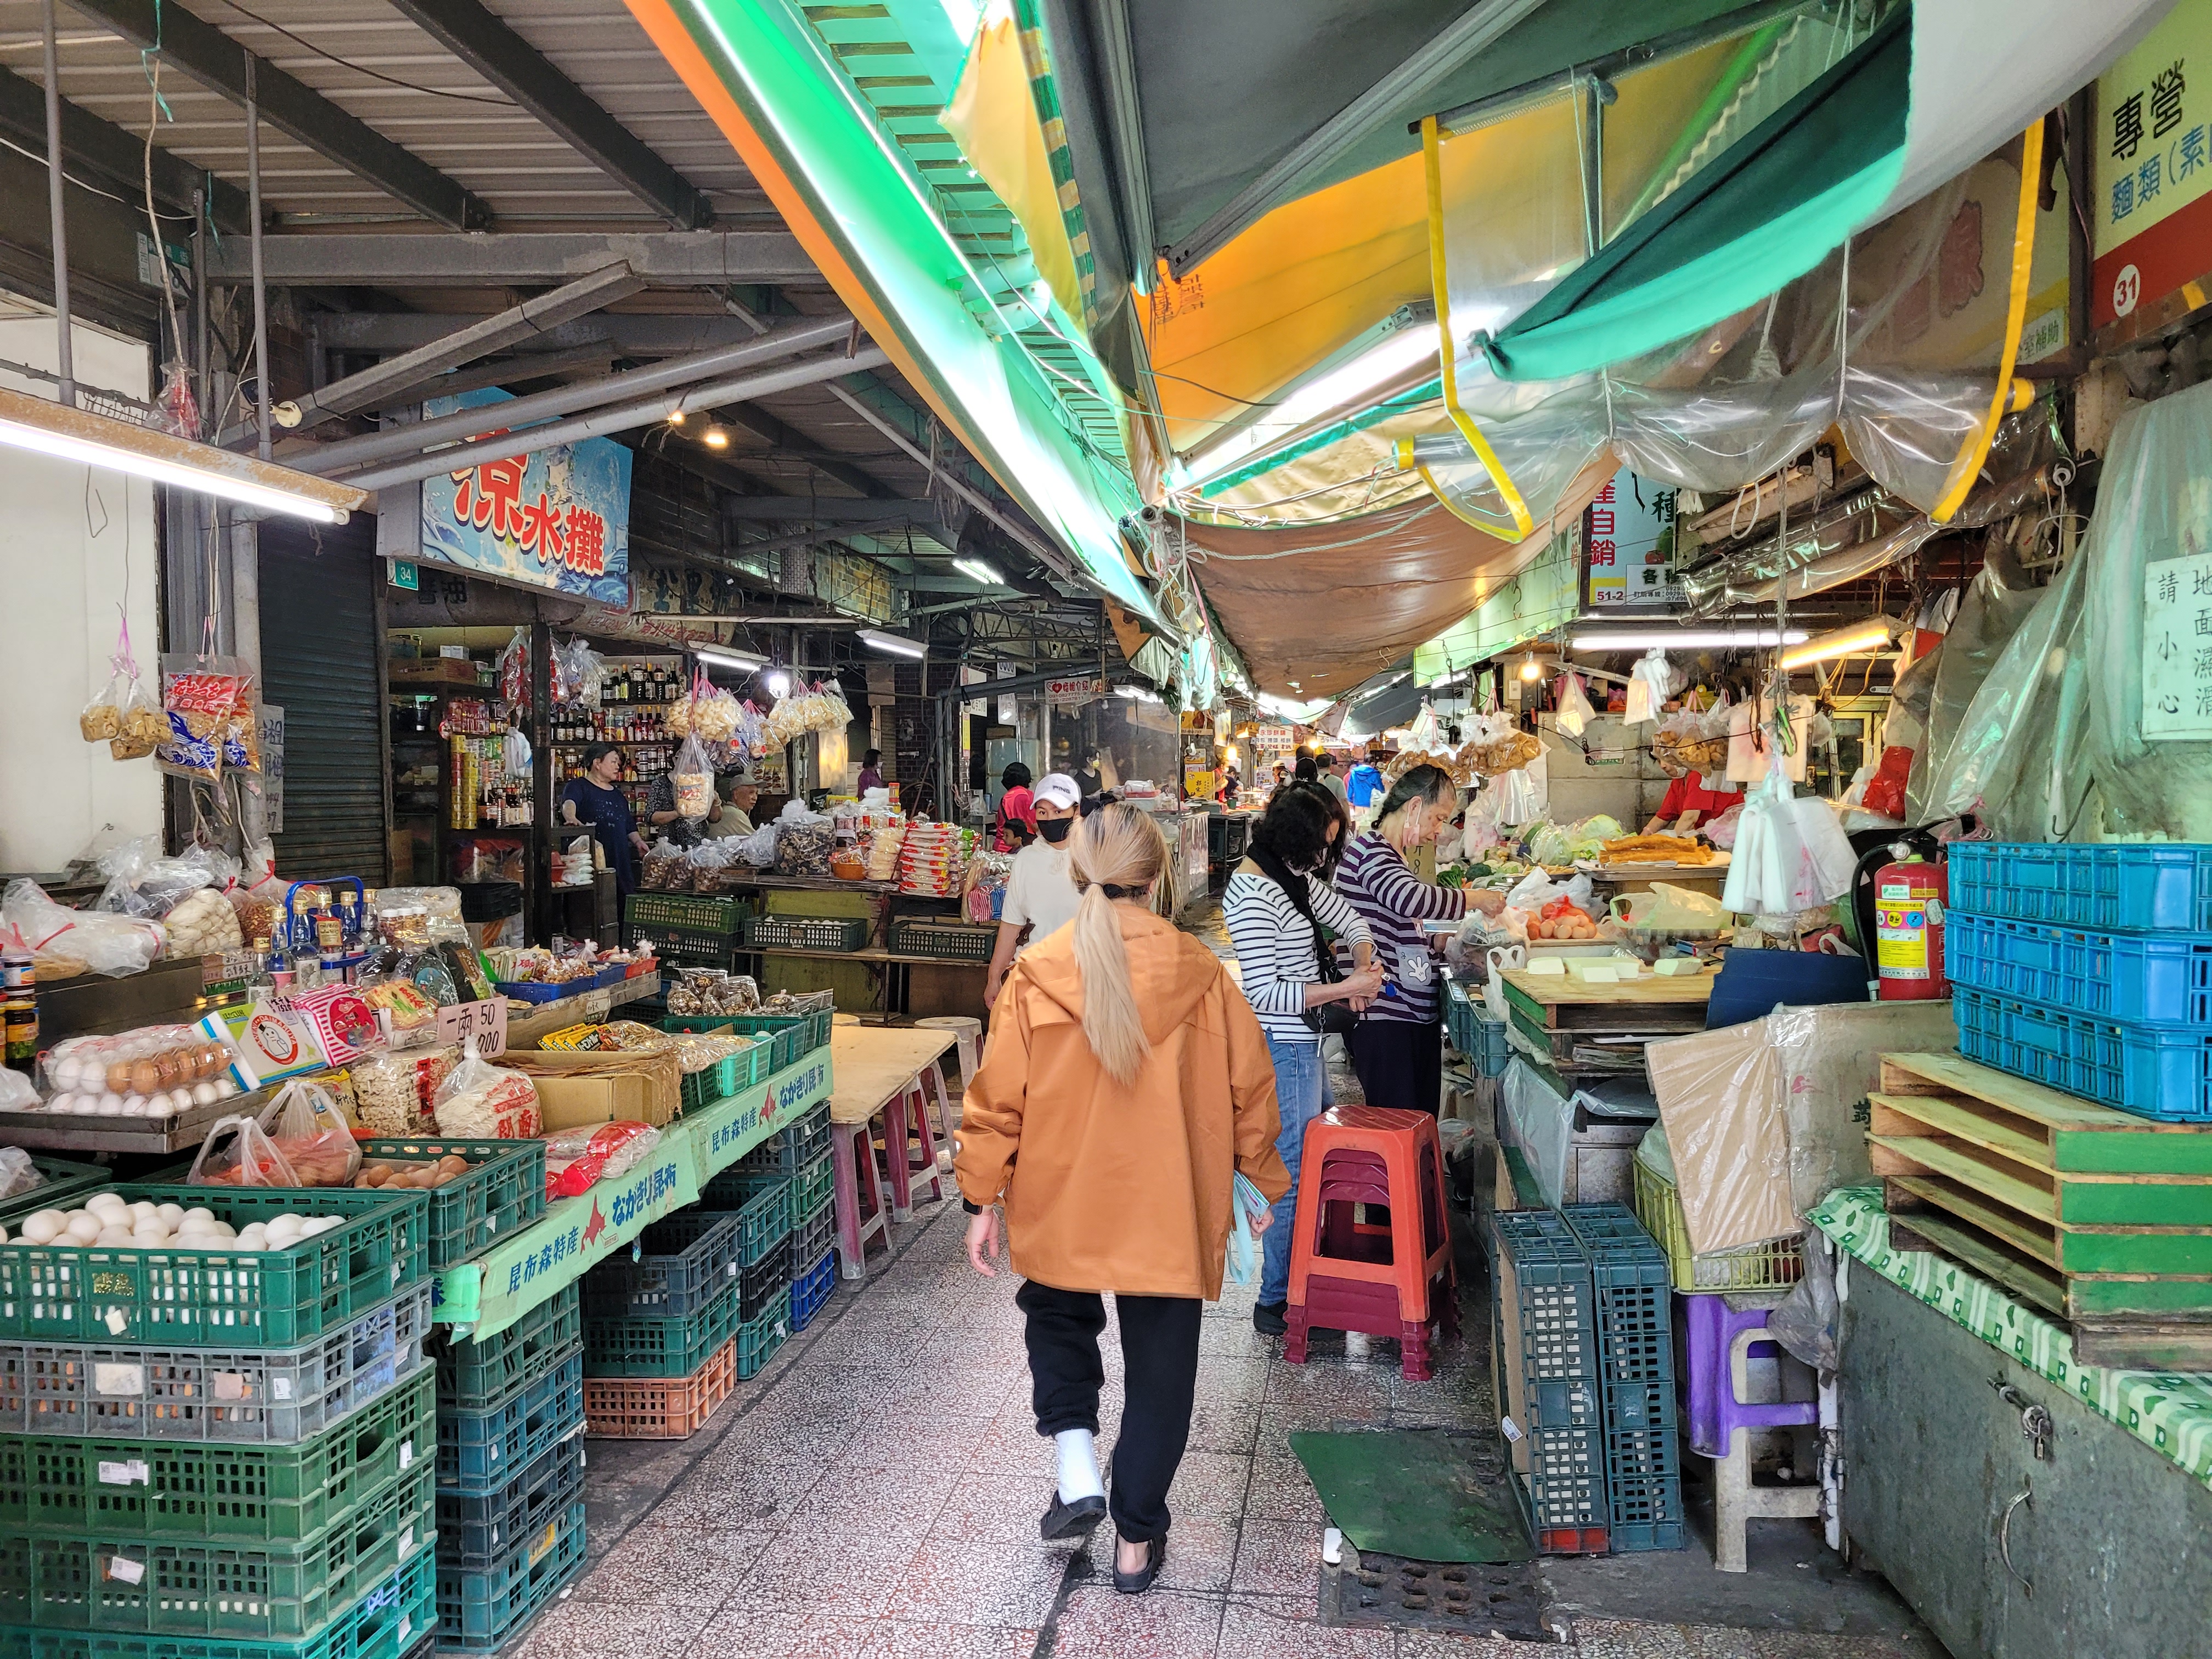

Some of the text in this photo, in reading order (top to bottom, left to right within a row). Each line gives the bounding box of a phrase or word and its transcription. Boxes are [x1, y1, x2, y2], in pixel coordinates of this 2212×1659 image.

[2112, 57, 2186, 161] 專營
[2111, 123, 2212, 225] 麵類(素
[2117, 273, 2137, 307] 31
[400, 567, 412, 582] 34
[1597, 590, 1624, 601] 51-2
[2157, 571, 2179, 714] 請小心
[1053, 785, 1071, 794] PING
[1413, 859, 1421, 874] 8
[481, 1003, 495, 1025] 50
[506, 1226, 579, 1298] 昆布森特産
[612, 1163, 676, 1227] ながきり昆布
